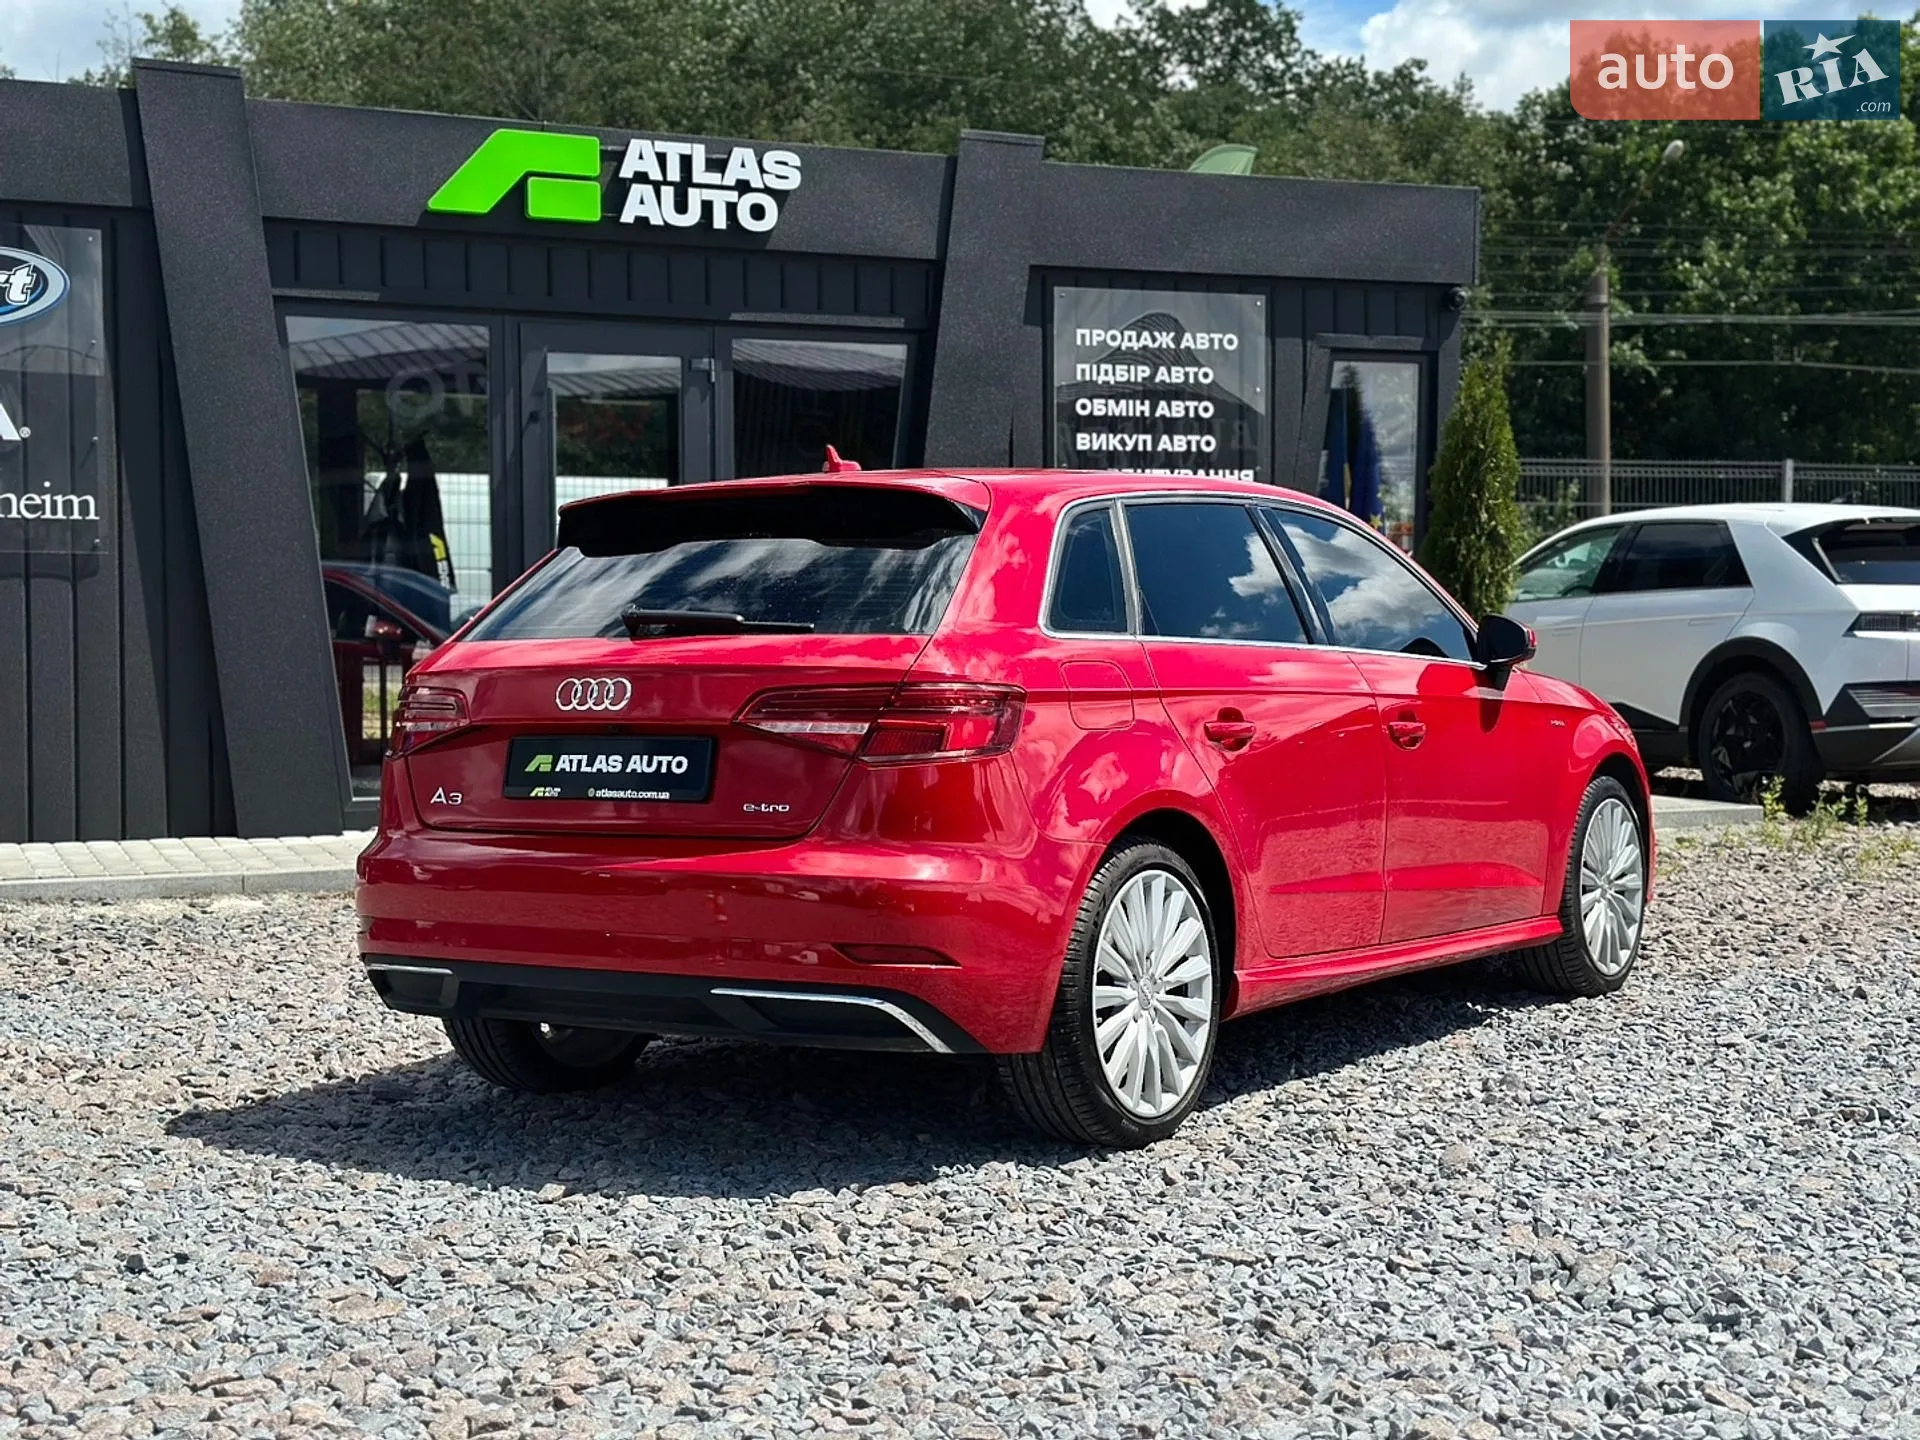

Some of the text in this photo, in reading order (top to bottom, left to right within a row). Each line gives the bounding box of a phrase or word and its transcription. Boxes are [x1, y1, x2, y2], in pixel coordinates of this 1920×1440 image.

[619, 138, 802, 190] ATLAS
[619, 184, 779, 232] AUTO
[1076, 328, 1239, 351] ПРОДАЖ АВТО
[1076, 363, 1214, 385] ПІДБІР АВТО
[1075, 397, 1214, 418] ОБМІН АВТО
[1076, 433, 1216, 452] ВИКУП АВТО
[555, 754, 689, 774] ATLAS AUTO
[430, 787, 463, 805] A3
